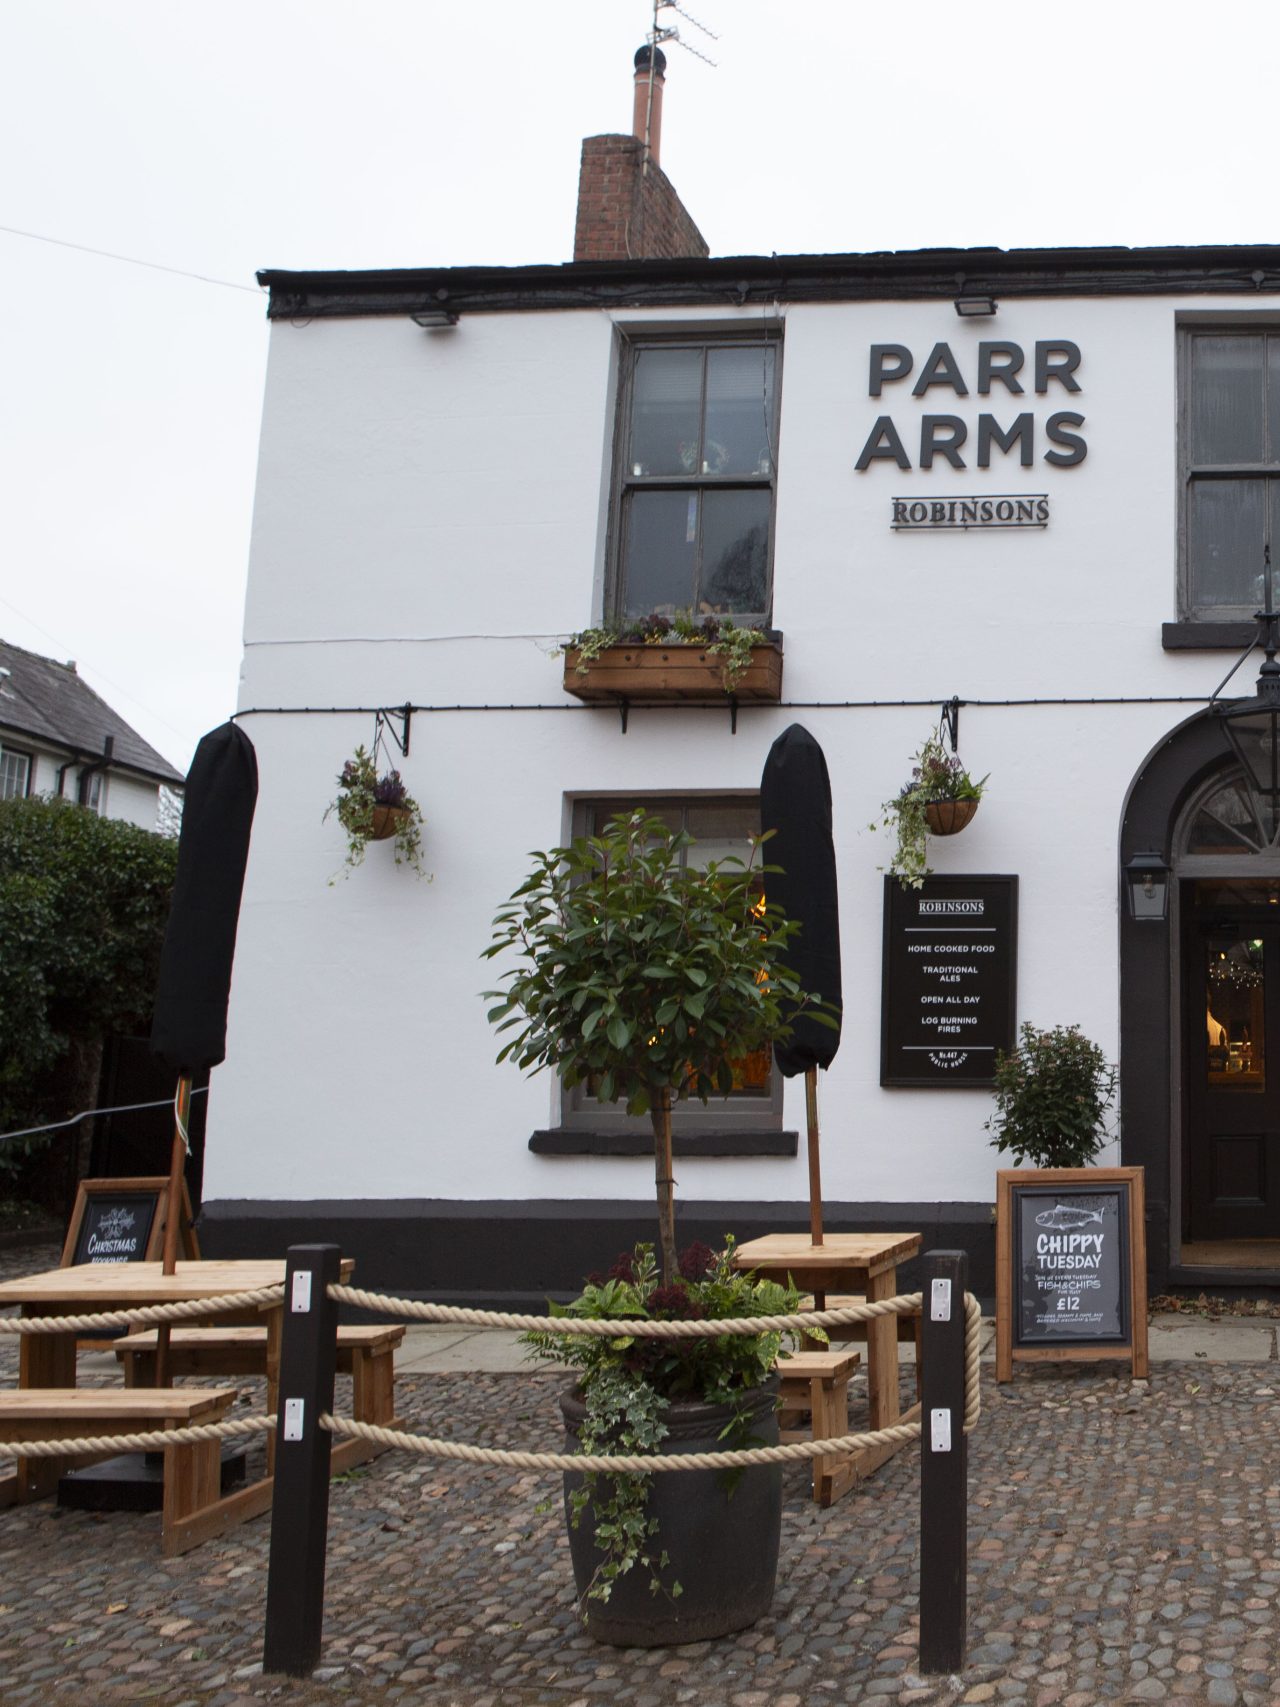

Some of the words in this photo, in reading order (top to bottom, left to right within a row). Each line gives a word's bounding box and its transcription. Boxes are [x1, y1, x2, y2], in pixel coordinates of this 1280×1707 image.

[869, 340, 1082, 396] PARR
[854, 411, 1088, 470] ARMS
[891, 499, 1050, 523] ROBINSONS
[919, 902, 984, 912] ROBINSONS
[908, 945, 931, 953] HOME
[934, 945, 969, 953] COOKED
[971, 945, 995, 953] FOOD
[928, 1052, 948, 1069] PUBLIC
[950, 1052, 968, 1068] HOUSE
[88, 1233, 137, 1255] CHRISTMAS
[1037, 1233, 1104, 1254] CHIPPY
[1037, 1254, 1102, 1269] TUESDAY
[1056, 1296, 1080, 1311] £12
